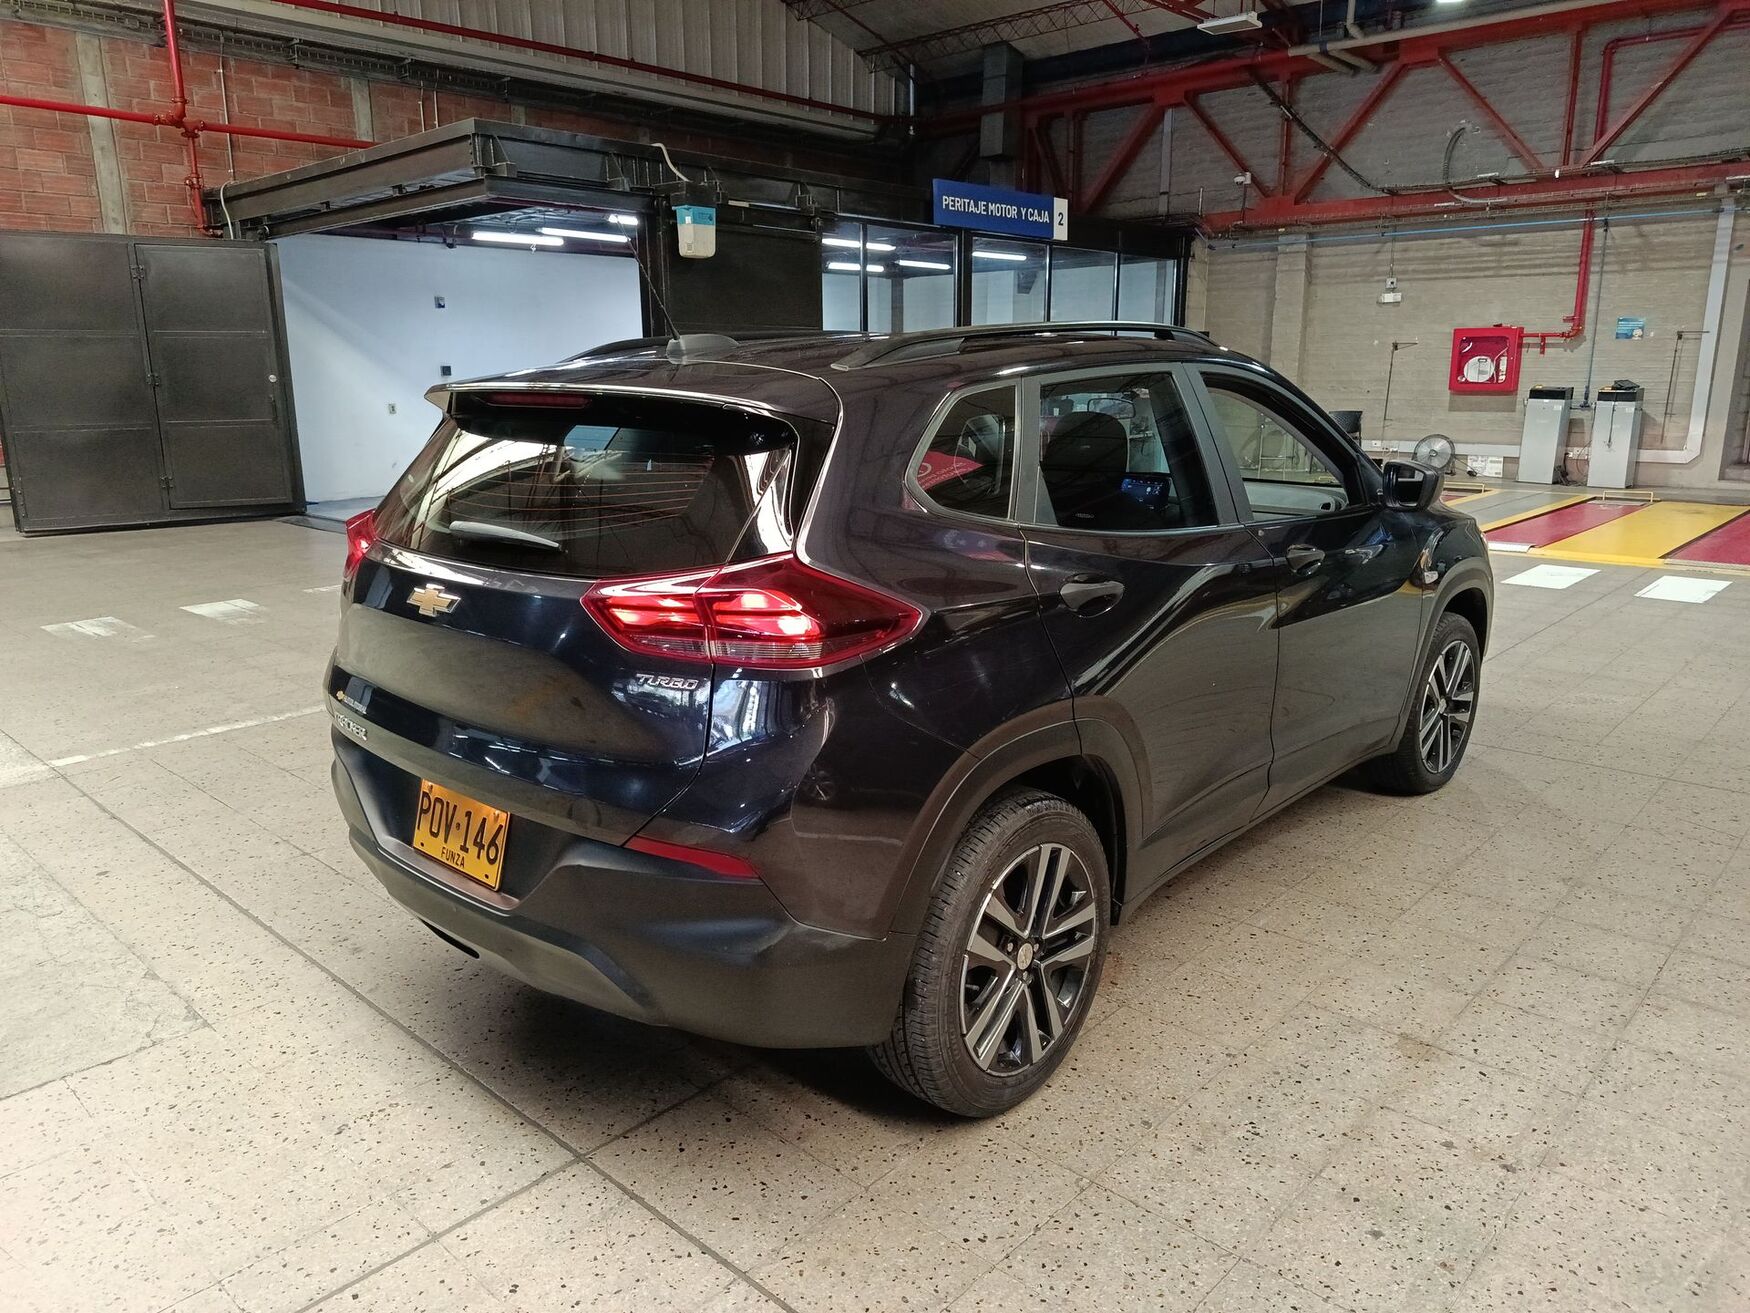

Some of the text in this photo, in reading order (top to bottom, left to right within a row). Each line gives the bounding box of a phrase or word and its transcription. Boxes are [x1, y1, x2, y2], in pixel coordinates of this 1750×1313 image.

[942, 195, 1050, 224] PERITAJE MOTOR Y CAJA
[1057, 212, 1064, 226] 2
[636, 673, 699, 690] TURBO
[440, 846, 466, 870] FUNZA
